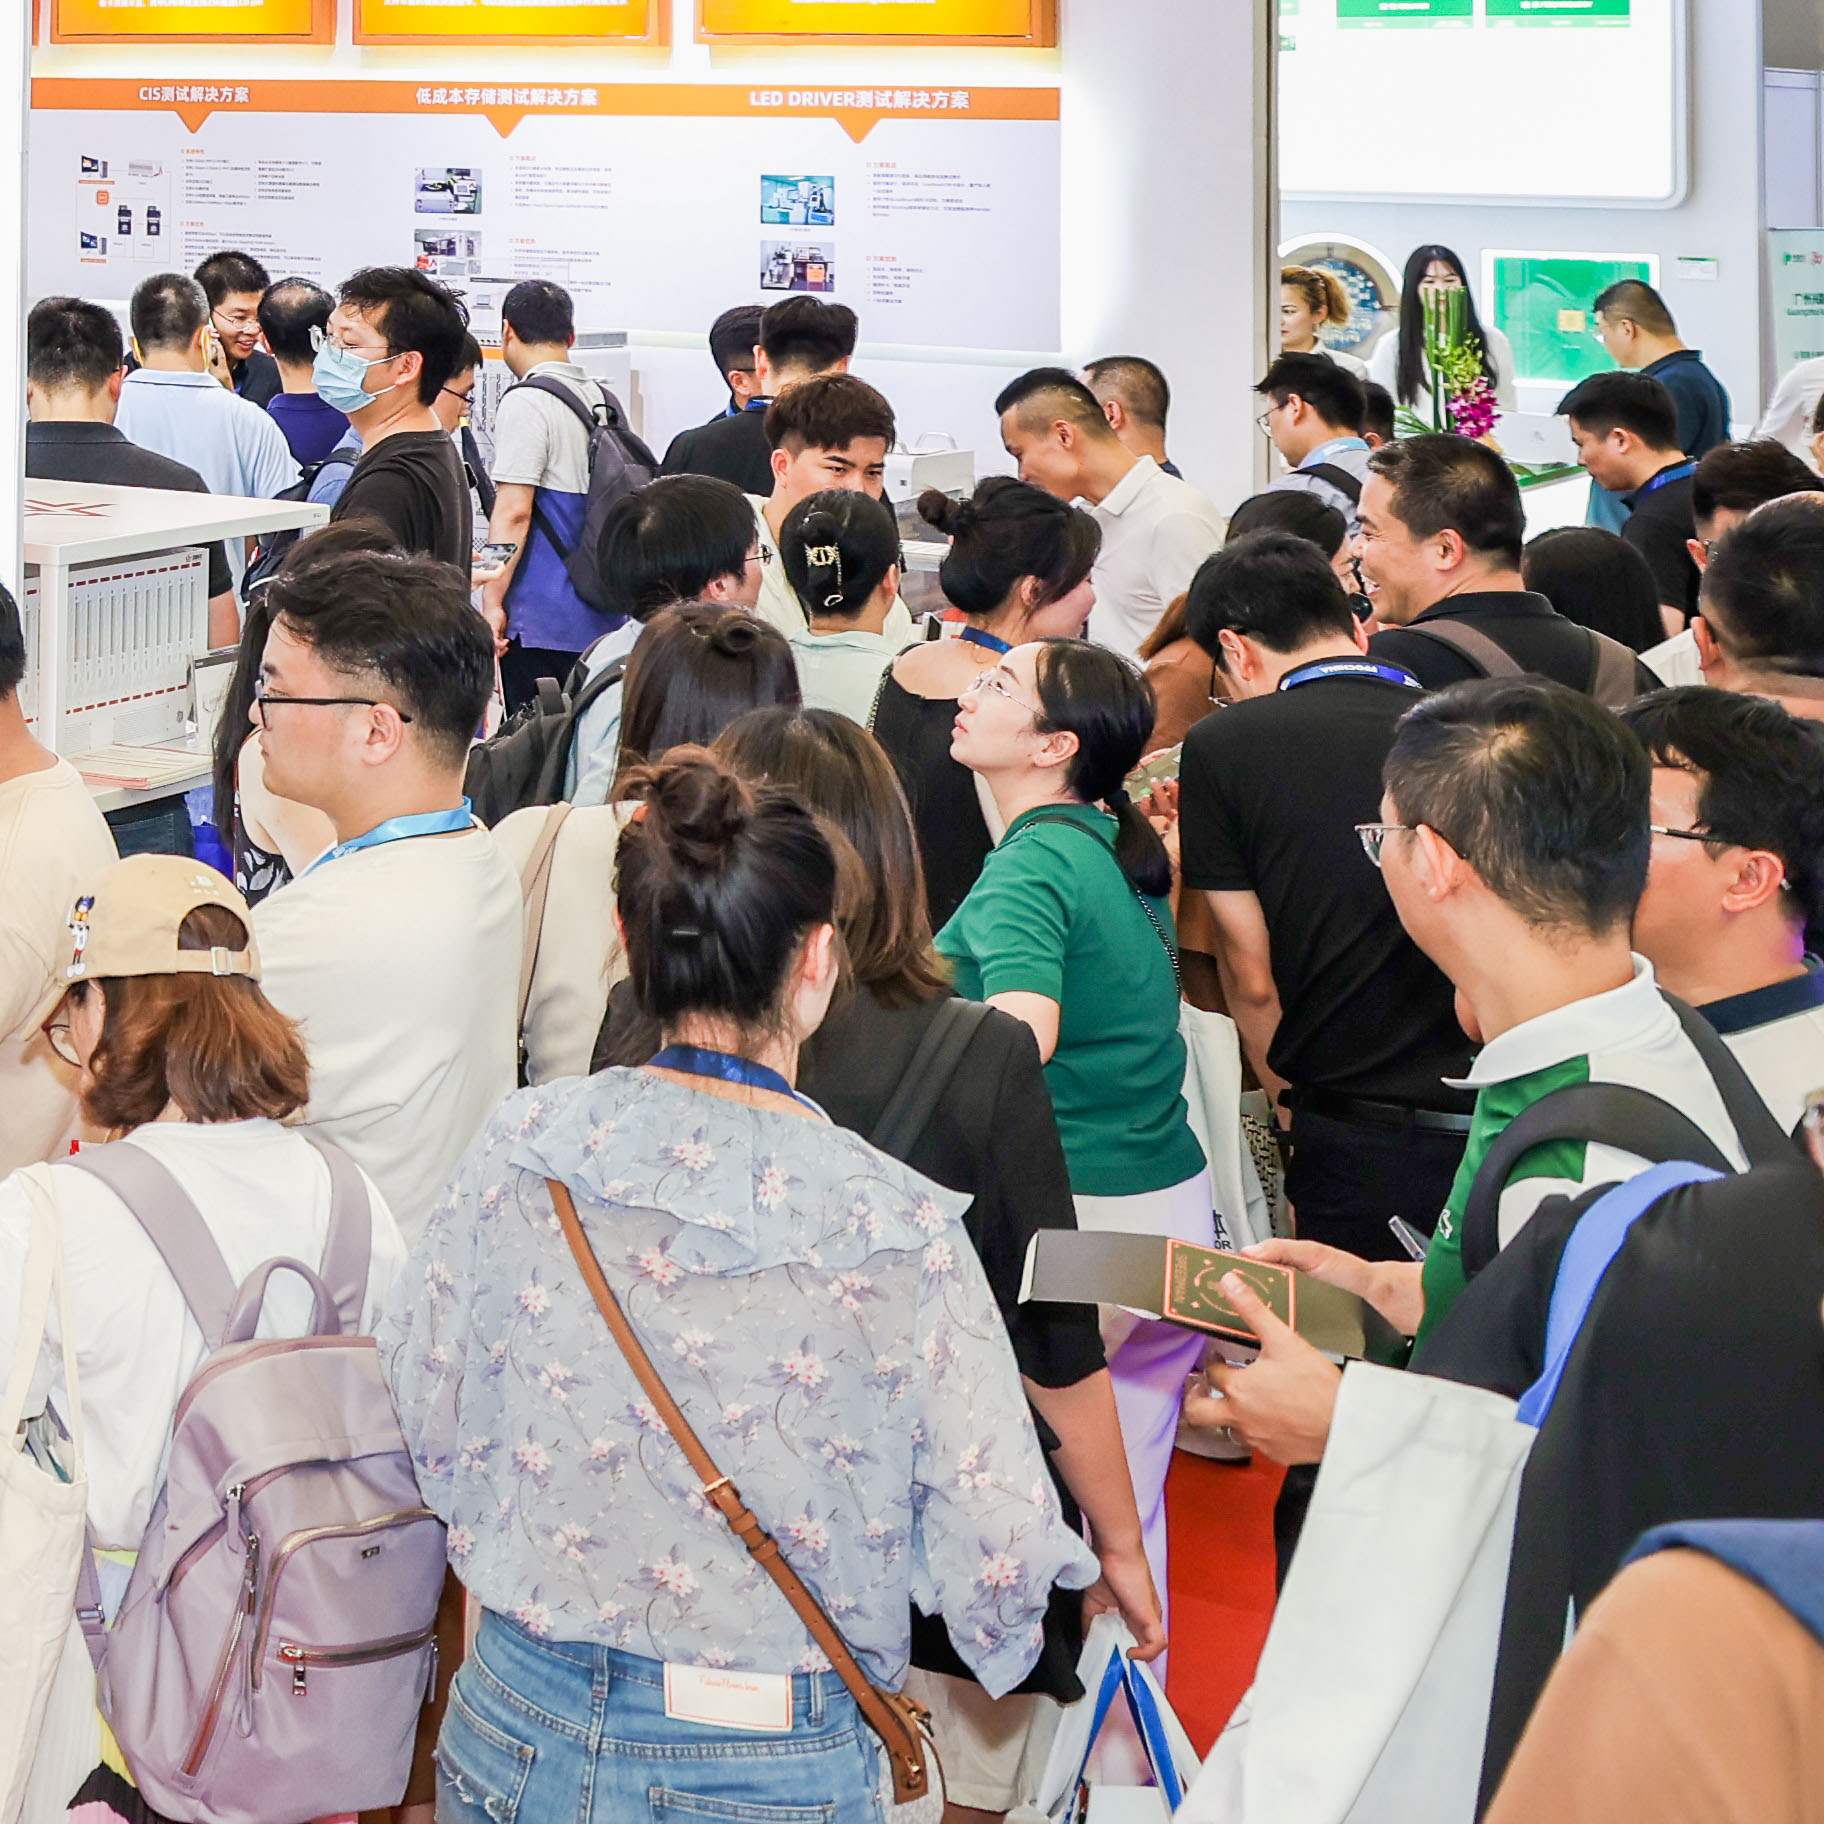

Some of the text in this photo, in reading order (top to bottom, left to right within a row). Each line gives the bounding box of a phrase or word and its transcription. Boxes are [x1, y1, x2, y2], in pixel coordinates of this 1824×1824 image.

[138, 84, 251, 106] CIS测试解决方案
[415, 86, 599, 108] 低成本存储测试解决方案
[749, 90, 783, 109] LED
